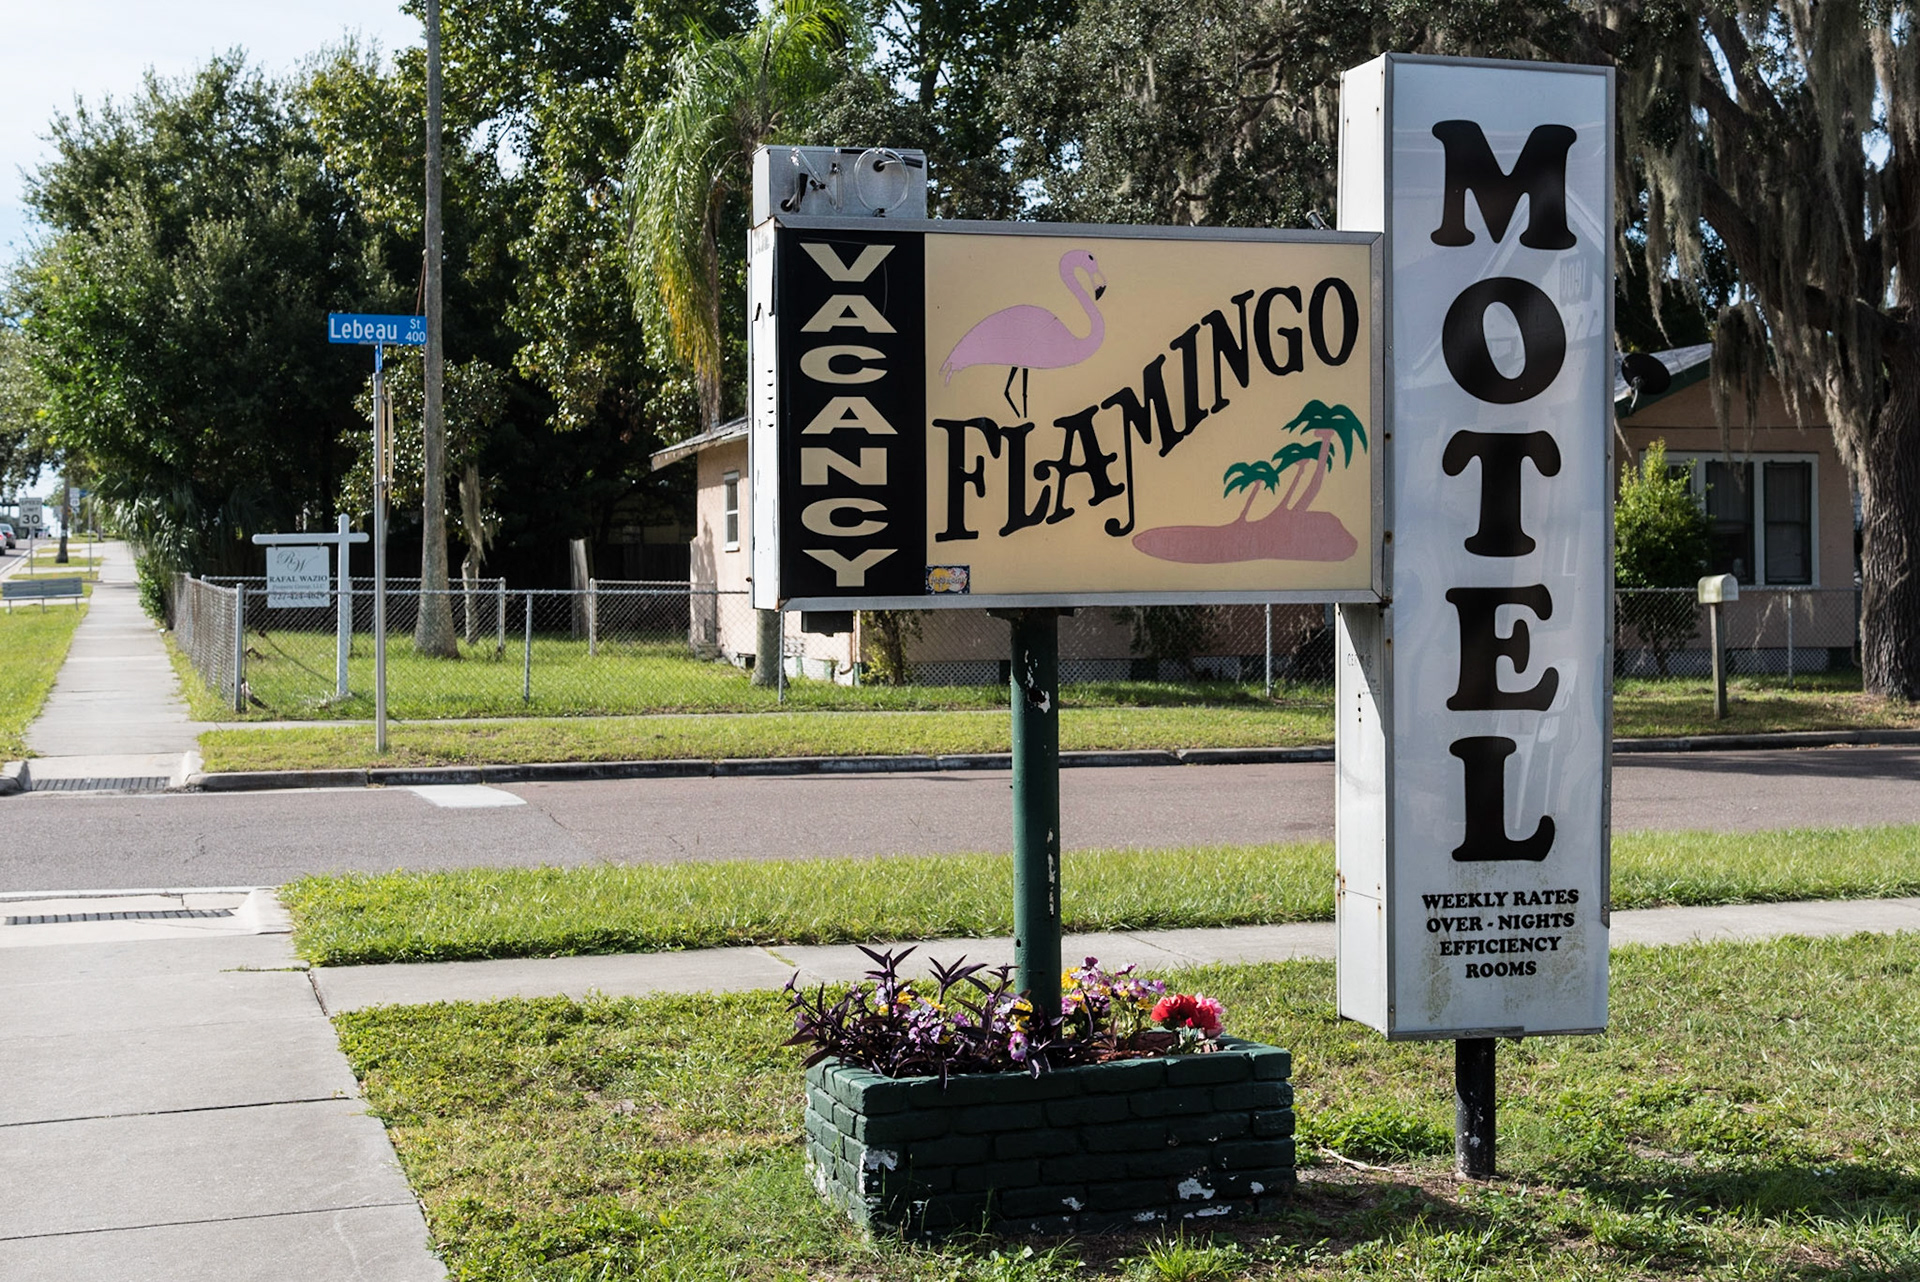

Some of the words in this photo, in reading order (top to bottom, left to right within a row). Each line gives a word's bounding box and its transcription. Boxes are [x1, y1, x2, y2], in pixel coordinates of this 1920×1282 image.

[330, 318, 397, 339] Lebeau
[410, 318, 420, 329] St
[405, 331, 425, 342] 400
[800, 243, 897, 588] VACANCY
[932, 277, 1359, 542] FLAMINGO
[1430, 119, 1577, 863] MOTEL
[22, 514, 40, 524] 30
[1422, 892, 1508, 909] WEEKLY
[1513, 889, 1579, 906] RATES
[1427, 917, 1483, 933] OVER
[1498, 913, 1575, 930] NIGHTS
[1440, 936, 1562, 956] EFFICIENCY
[1466, 961, 1537, 978] ROOMS
